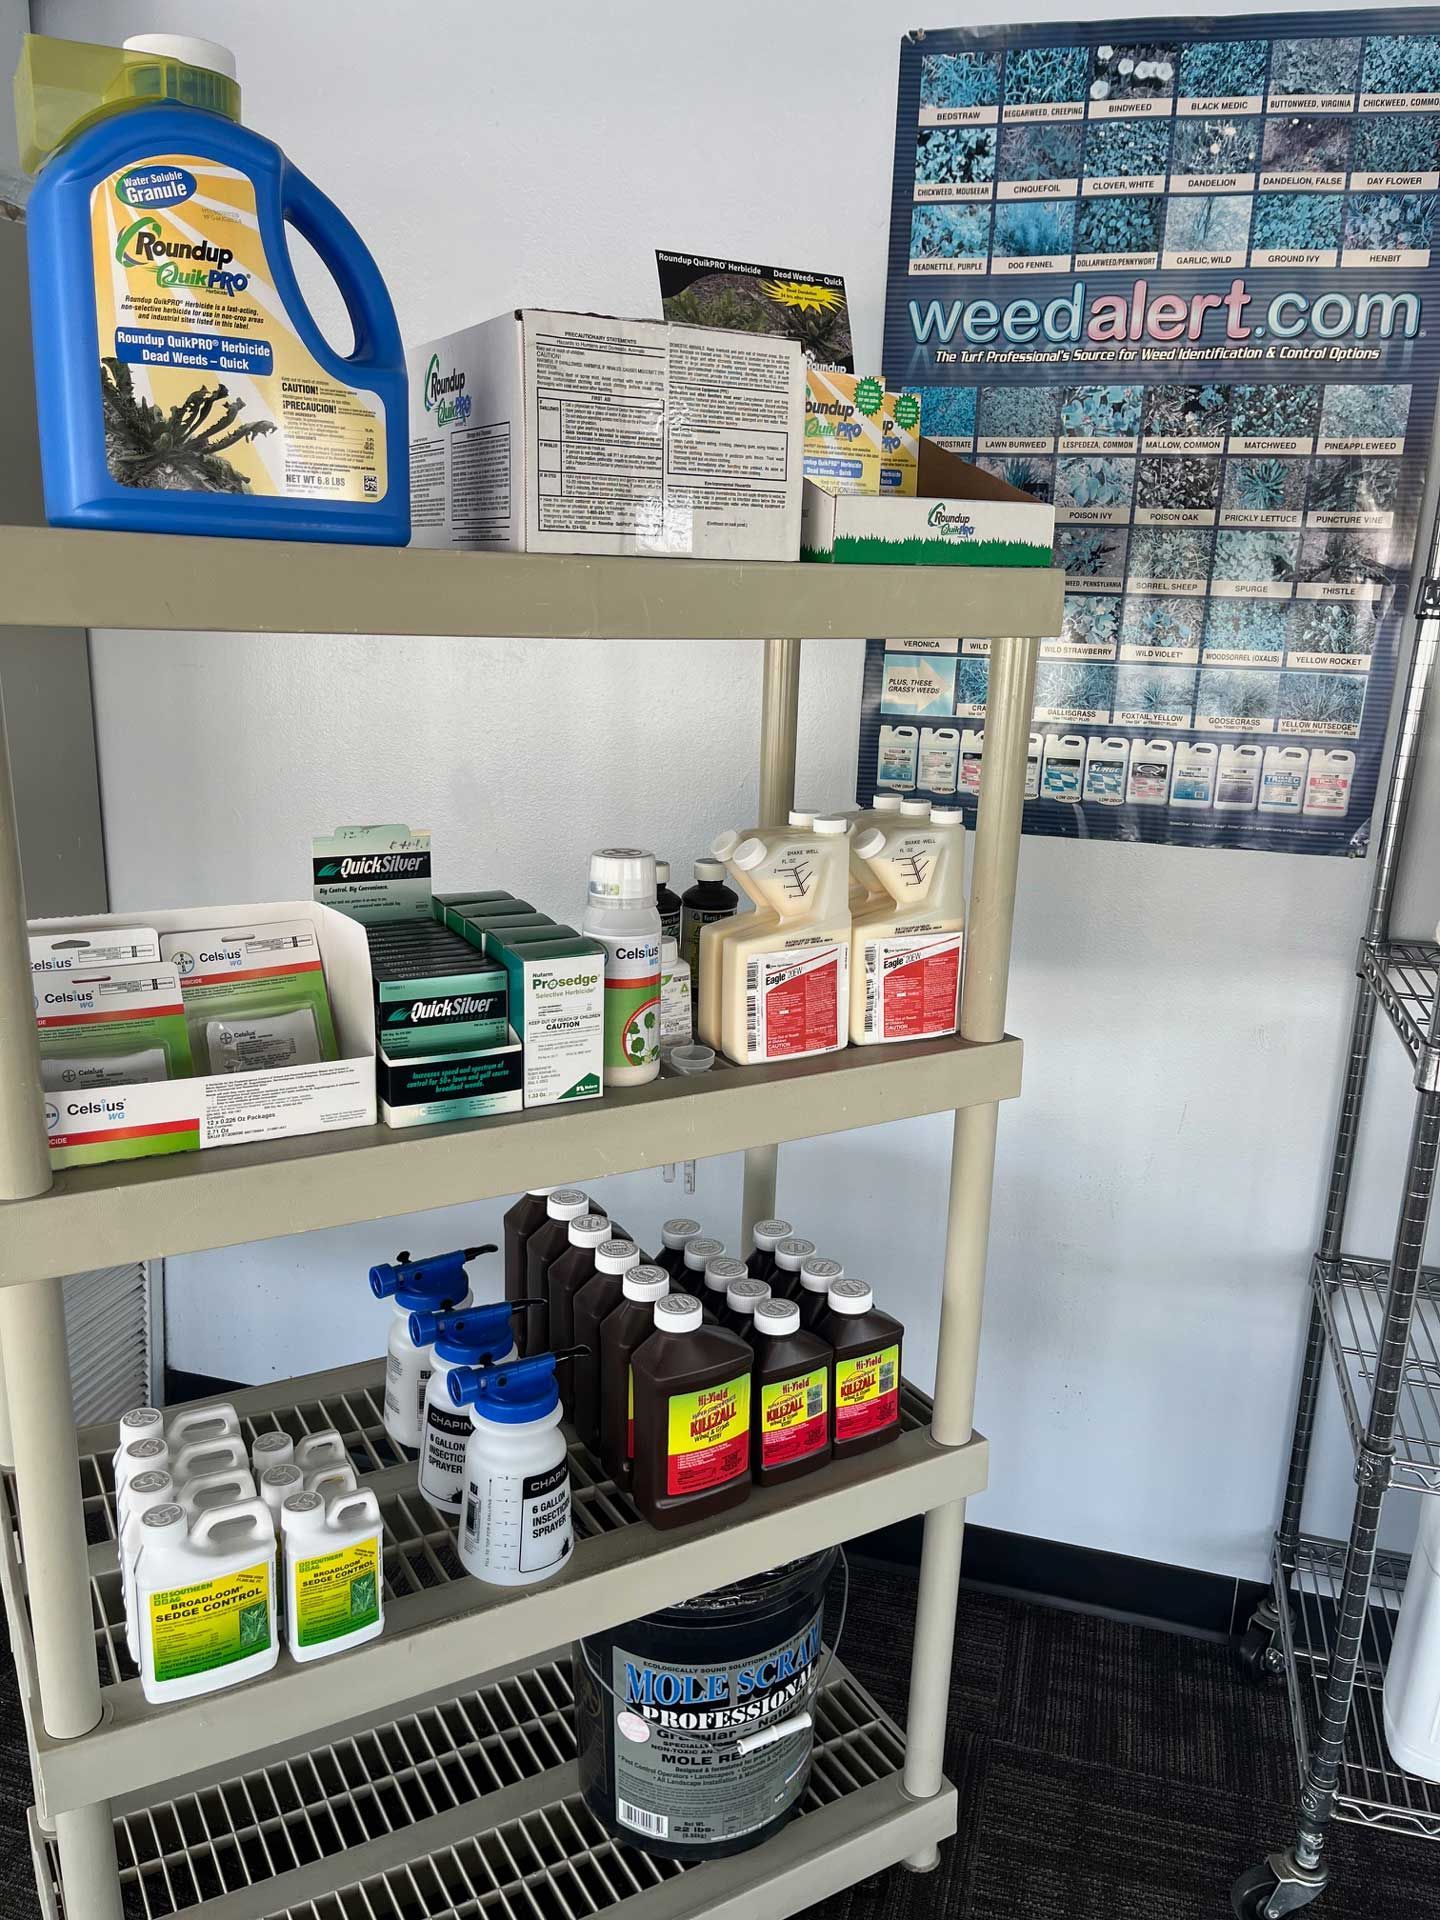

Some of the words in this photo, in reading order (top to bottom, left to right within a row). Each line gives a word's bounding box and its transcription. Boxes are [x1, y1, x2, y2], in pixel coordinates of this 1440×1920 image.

[1109, 104, 1152, 112] BINDWEED
[1191, 102, 1220, 110] BLACK
[1270, 100, 1319, 109] BUTTONWEED,
[1321, 100, 1351, 108] VIRGINIA
[1363, 99, 1409, 107] CHICKWEED,
[937, 112, 981, 120] BEDSTRAW
[1051, 107, 1082, 116] CREEPING
[124, 177, 149, 186] Water
[152, 171, 182, 182] Soluble
[1263, 177, 1314, 186] DANDELION,
[1315, 177, 1342, 185] FALSE
[1367, 177, 1385, 185] DAY
[1387, 177, 1422, 185] FLOWER
[956, 187, 989, 195] MOUSEEAR
[1014, 185, 1061, 193] CINQUEFOIL
[1093, 182, 1127, 190] CLOVER,
[1128, 181, 1154, 189] WHITE
[127, 183, 188, 203] Granule
[136, 232, 233, 269] Roundup
[1177, 256, 1209, 265] GARLIC,
[1268, 255, 1304, 263] GROUND
[1306, 255, 1320, 263] IVY
[1370, 255, 1402, 263] HENBIT
[658, 253, 692, 266] Roundup
[728, 263, 762, 275] Herbicide
[774, 270, 791, 279] Dead
[792, 273, 814, 282] Weeds
[824, 276, 843, 286] Quick
[958, 262, 982, 270] PURPLE
[1008, 261, 1023, 269] DOG
[1025, 261, 1053, 269] FENNEL
[125, 295, 152, 304] Roundup
[185, 300, 213, 310] Herbicide
[163, 307, 191, 315] herbicide
[908, 279, 1422, 344] weedalert.com
[151, 314, 179, 322] industrial
[565, 332, 606, 341] PRECAUTIONARY
[607, 336, 636, 344] STATEMENTS
[117, 331, 164, 347] Roundup
[222, 341, 270, 357] Herbicide
[142, 350, 169, 362] Dead
[172, 353, 208, 366] Weeds
[220, 359, 249, 370] Quick
[936, 351, 957, 362] The
[960, 351, 982, 362] Turf
[986, 350, 1070, 363] Professional's
[1073, 349, 1115, 361] Source
[1119, 348, 1138, 361] for
[1141, 348, 1174, 361] Weed
[1178, 347, 1262, 360] Identification
[1266, 346, 1276, 358] &
[1279, 347, 1327, 359] Control
[1329, 347, 1380, 361] Options
[282, 383, 318, 395] CAUTION!
[431, 368, 465, 402] Roundup
[936, 440, 971, 449] PROSTRATE
[985, 441, 1007, 449] LAWN
[1009, 441, 1047, 449] BURWEED
[1062, 441, 1101, 449] LESPEDEZA,
[1103, 441, 1133, 449] COMMON
[1146, 441, 1182, 450] MALLOW,
[1183, 441, 1220, 449] COMMON
[1244, 442, 1297, 450] MATCHWEED
[1325, 442, 1396, 450] PINEAPPLEWEED
[286, 474, 301, 483] NET
[303, 475, 315, 484] WT
[935, 511, 970, 525] Roundup
[1069, 512, 1098, 520] POISON
[1100, 512, 1112, 520] IVY
[1150, 513, 1181, 521] POISON
[1182, 513, 1199, 521] OAK
[1261, 515, 1297, 523] LETTUCE
[1316, 516, 1361, 524] PUNCTURE
[1322, 587, 1355, 595] THISTLE
[1063, 647, 1112, 655] STRAWBERRY
[1252, 654, 1279, 664] (OXALIS)
[1296, 657, 1327, 665] YELLOW
[1329, 658, 1362, 666] ROCKET
[889, 678, 909, 686] PLUS,
[888, 685, 915, 693] GRASSY
[916, 686, 940, 694] WEEDS
[1153, 714, 1183, 722] YELLOW
[1209, 718, 1260, 726] GOOSEGRASS
[341, 855, 423, 878] QuickSilver
[200, 949, 241, 962] Celsius
[616, 944, 659, 960] Celsius
[883, 957, 904, 969] Eagle
[765, 973, 787, 986] Eagle
[45, 990, 93, 1004] Celsius
[536, 990, 564, 999] Selective
[565, 988, 594, 996] Herbicide
[410, 996, 494, 1023] QuickSilver
[546, 1021, 580, 1030] CAUTION
[413, 1071, 440, 1079] Increases
[442, 1067, 458, 1077] speed
[472, 1063, 497, 1073] spectrum
[407, 1079, 428, 1089] control
[468, 1073, 479, 1081] and
[492, 1069, 509, 1077] course
[436, 1083, 464, 1094] broadleaf
[67, 1099, 124, 1117] Celsius
[108, 1112, 124, 1121] WG
[856, 1355, 882, 1371] Hi-Yield
[782, 1377, 810, 1394] Hi-Yield
[698, 1388, 728, 1406] Hi-Yield
[431, 1412, 473, 1431] CHAPIN
[435, 1437, 465, 1452] GALLON
[429, 1455, 462, 1474] SPRAYER
[530, 1464, 567, 1492] CHAPIN
[532, 1505, 538, 1514] 6
[541, 1489, 566, 1512] GALLON
[532, 1515, 566, 1539] SPRAYER
[311, 1552, 343, 1565] SOUTHERN
[303, 1574, 332, 1587] SEDGE
[335, 1560, 374, 1579] CONTROL
[314, 1559, 361, 1578] BROADLOOM
[169, 1582, 213, 1598] SOUTHERN
[171, 1587, 240, 1610] BROADLOOM
[156, 1608, 199, 1623] SEDGE
[203, 1588, 262, 1613] CONTROL
[643, 1660, 698, 1674] ECOLOGICALLY
[700, 1666, 726, 1674] SOUND
[728, 1656, 767, 1671] SOLUTIONS
[624, 1662, 729, 1706] MOLE
[661, 1754, 713, 1766] MOLE
[657, 1770, 689, 1779] Operators
[694, 1770, 735, 1779] Landscapers
[667, 1779, 701, 1787] Landscape
